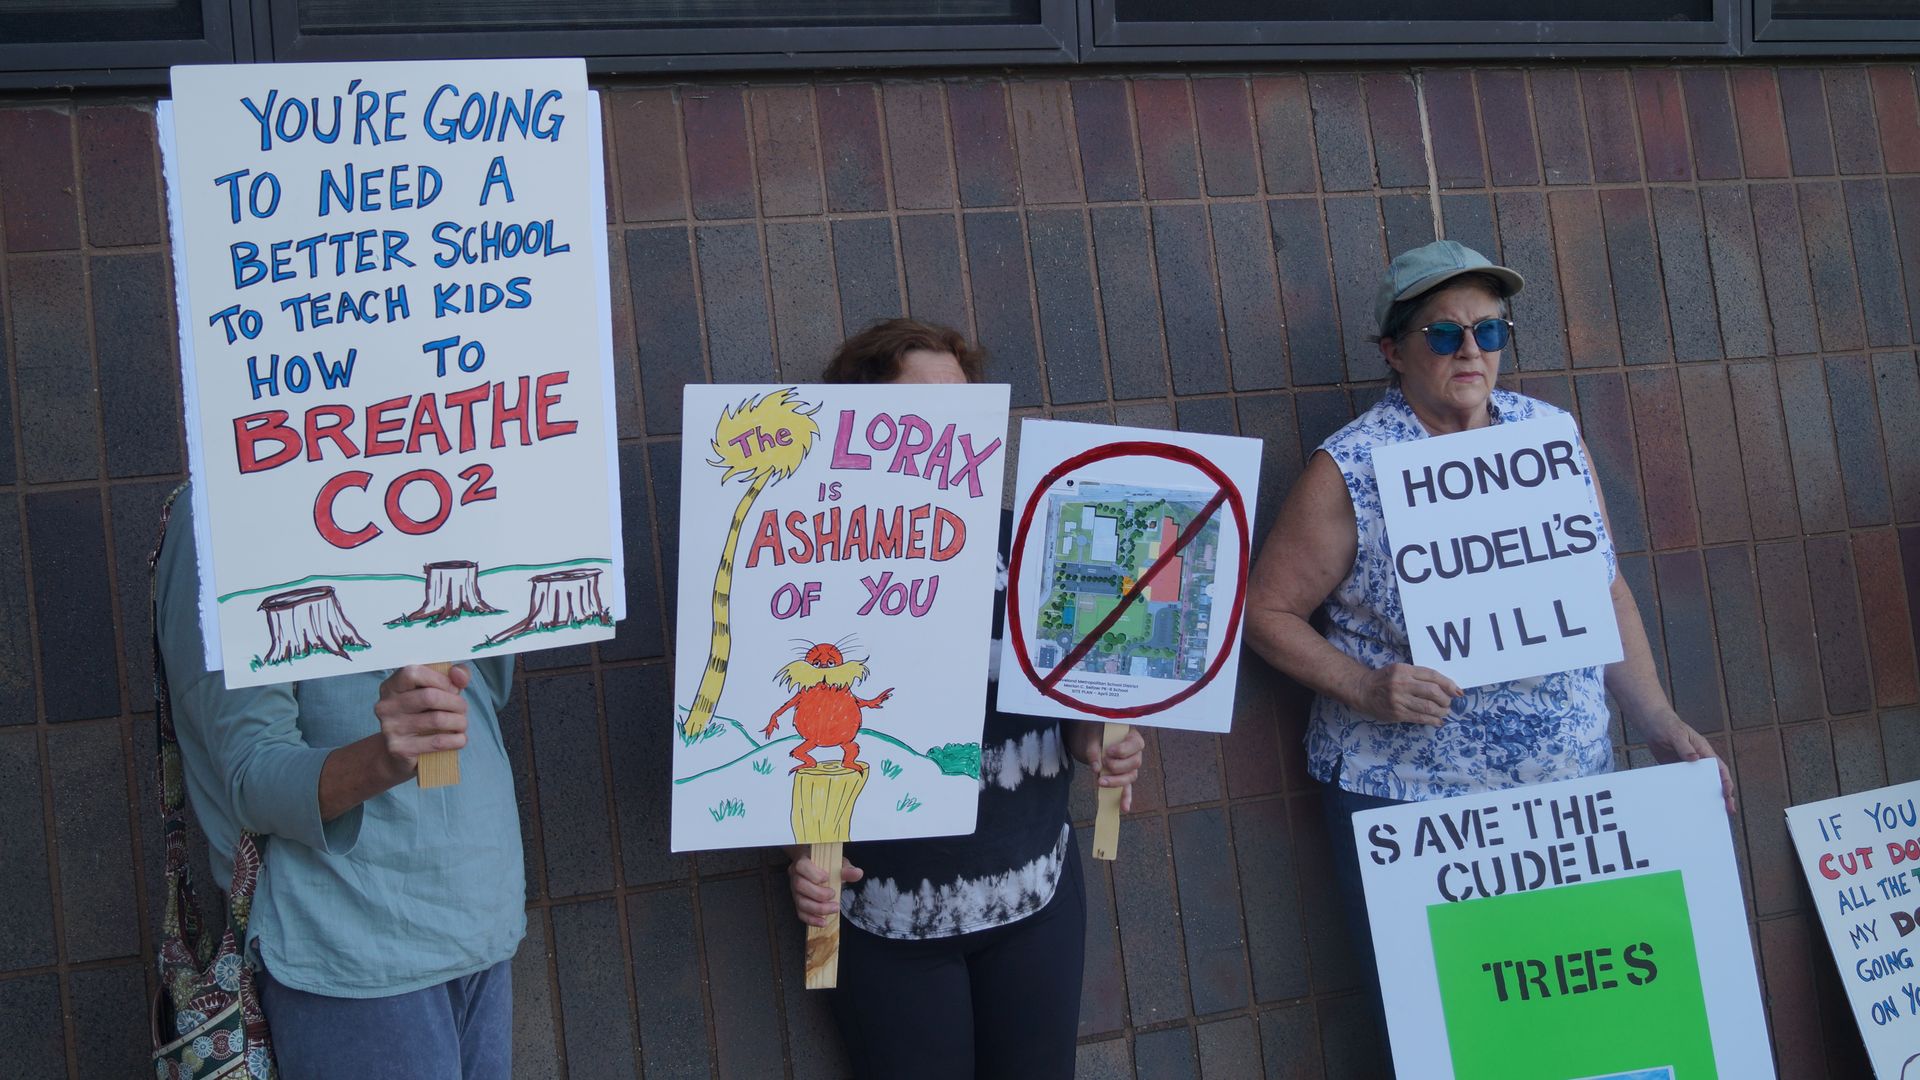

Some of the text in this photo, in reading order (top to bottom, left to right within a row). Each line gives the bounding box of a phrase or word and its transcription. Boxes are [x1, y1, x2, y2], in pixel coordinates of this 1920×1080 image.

[240, 79, 565, 151] YOU'RE GOING
[215, 156, 515, 223] TO NEED A
[230, 219, 570, 289] BETTER SCHOOL
[209, 277, 532, 345] TO TEACH KIDS
[247, 335, 485, 400] HOW TO
[232, 371, 578, 474] BREATHE
[729, 410, 1001, 498] The LORAX
[818, 481, 842, 502] IS
[1401, 440, 1581, 507] HONOR
[745, 503, 966, 568] ASHAMED
[1396, 513, 1597, 584] CUDELL'S
[771, 571, 940, 620] OF YOU
[1426, 599, 1587, 661] WILL
[1368, 790, 1618, 865] SAVE THE
[1817, 799, 1917, 842] IF YOU
[1437, 830, 1650, 902] CUDELL
[1818, 846, 1873, 880] CUT
[1837, 885, 1876, 916] ALL
[1877, 872, 1911, 901] THE
[1849, 919, 1879, 950] MY
[1856, 948, 1914, 983] GOING
[1481, 942, 1658, 1002] TREES
[1871, 995, 1900, 1026] ON
